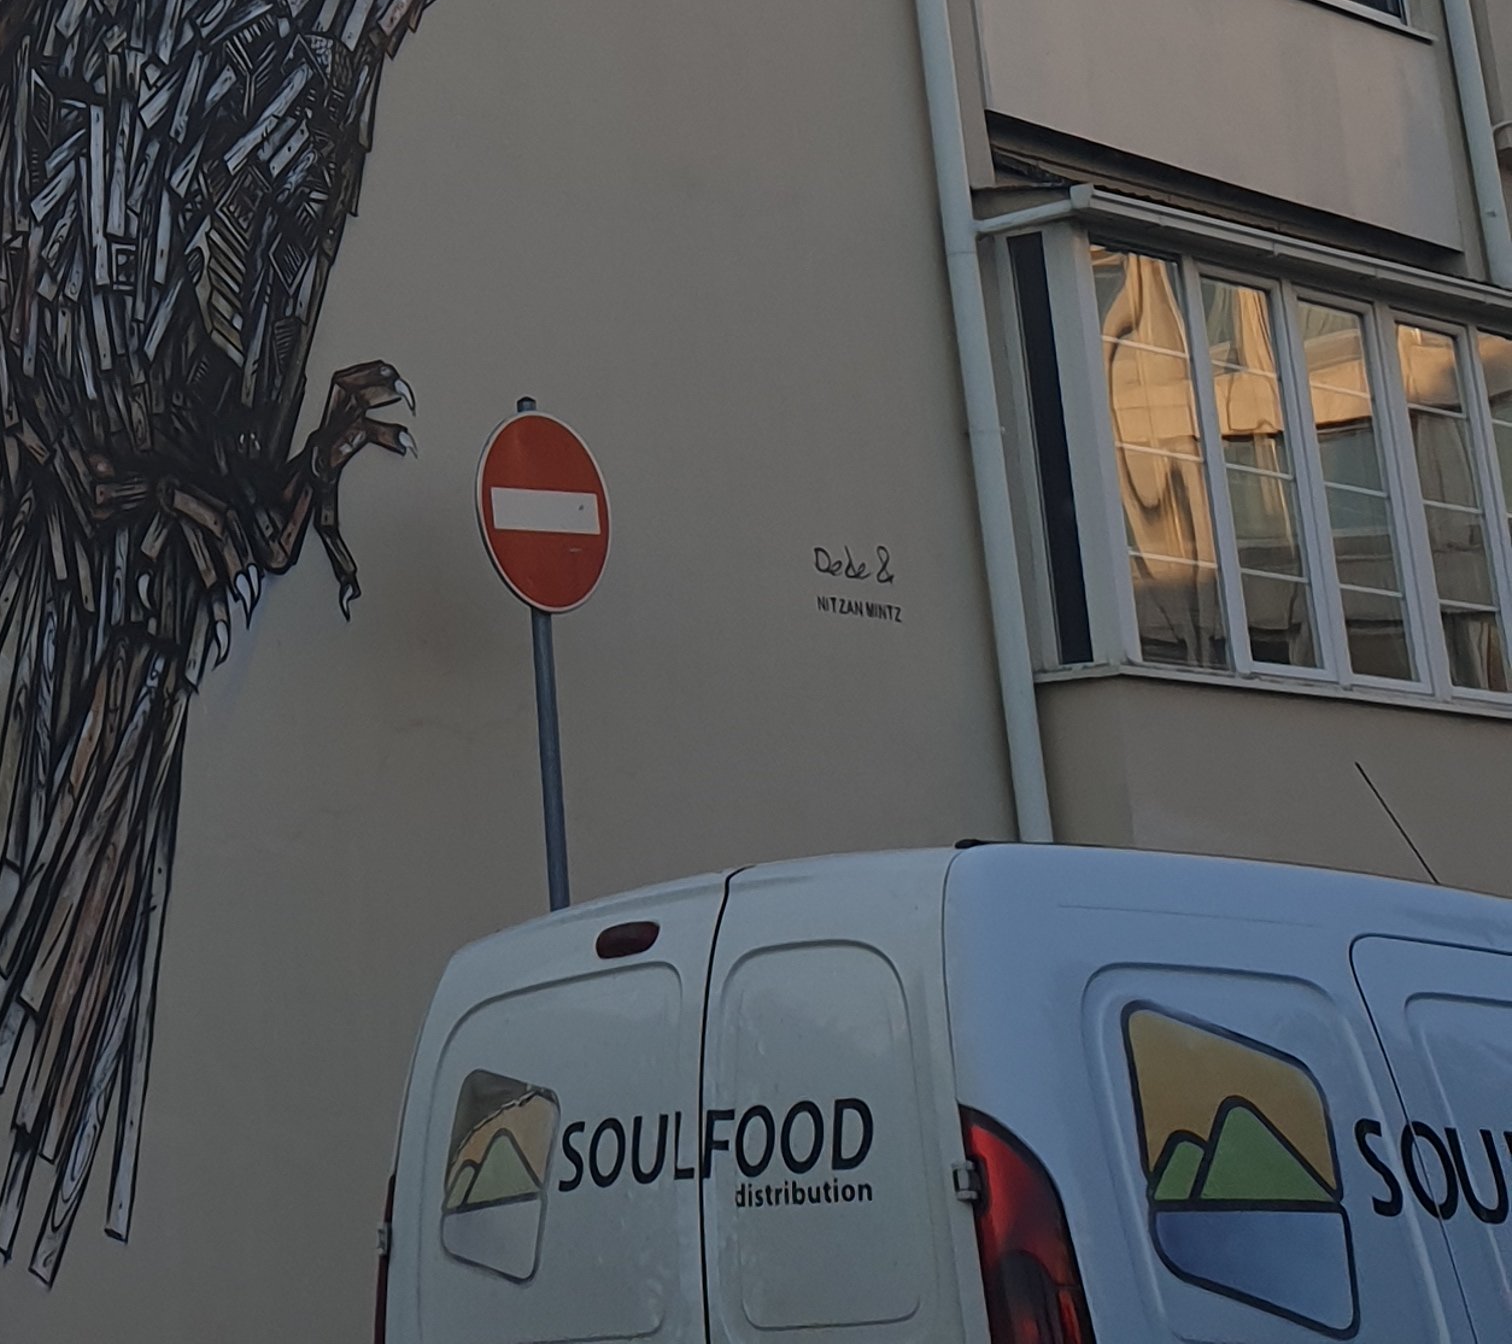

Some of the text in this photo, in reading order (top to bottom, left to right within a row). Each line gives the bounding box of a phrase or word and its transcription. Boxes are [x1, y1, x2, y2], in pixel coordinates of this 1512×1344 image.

[875, 545, 895, 585] &
[816, 595, 864, 618] NITZAN
[558, 1097, 874, 1193] SOULFOOD
[734, 1179, 874, 1208] distribution
